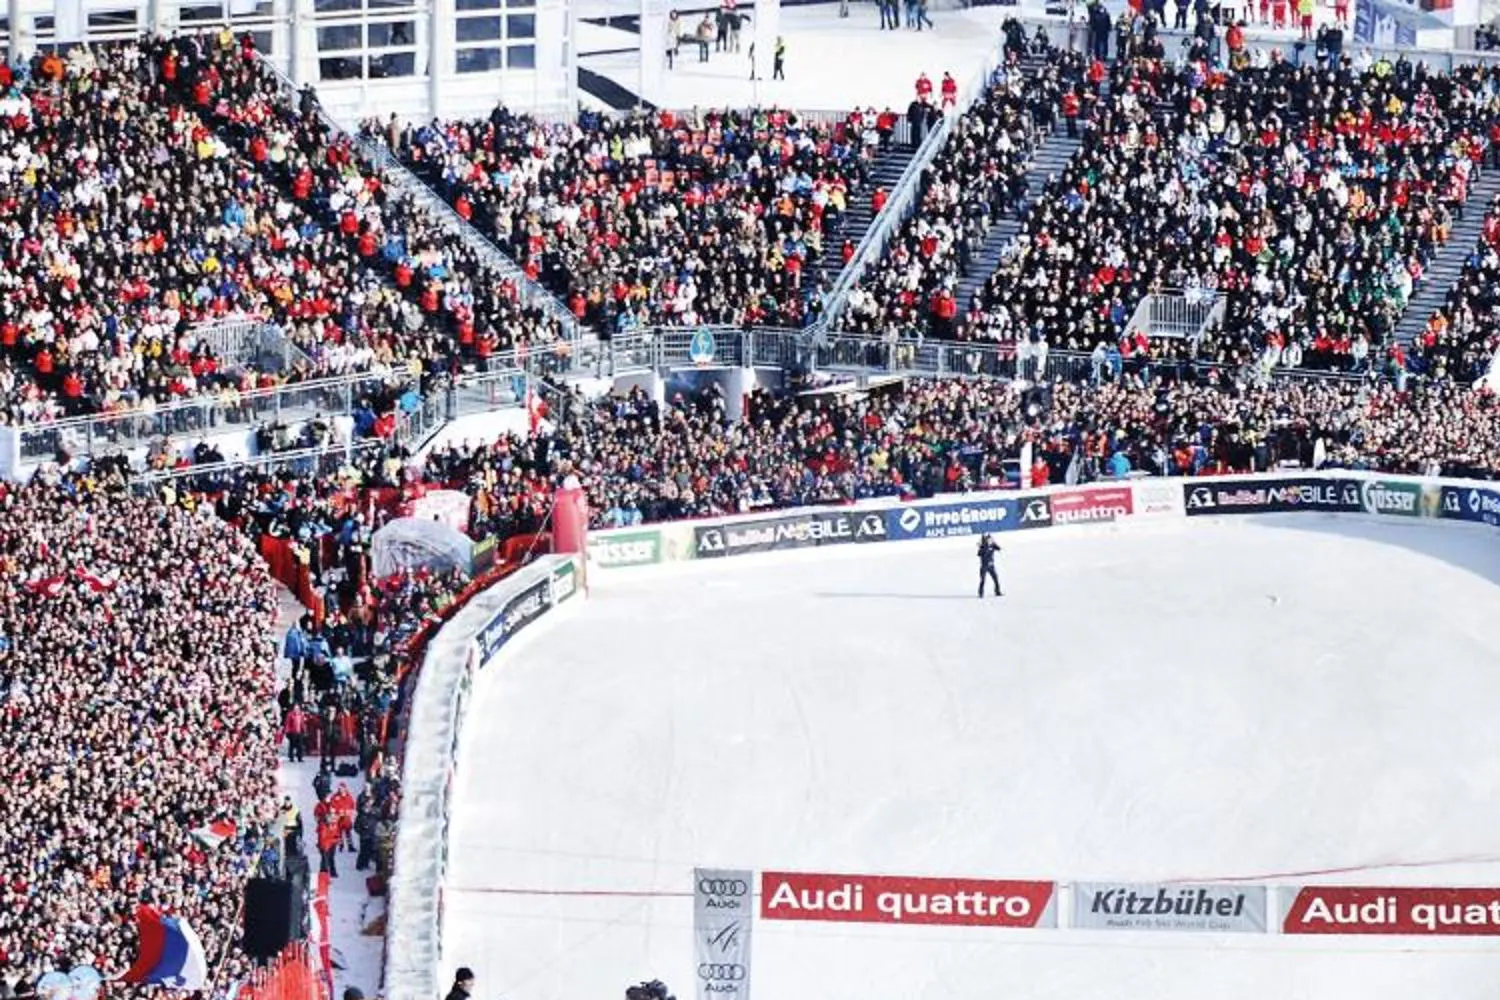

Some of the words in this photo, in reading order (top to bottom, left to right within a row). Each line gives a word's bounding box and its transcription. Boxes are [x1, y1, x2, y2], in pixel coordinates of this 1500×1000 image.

[1020, 499, 1051, 524] A1
[699, 530, 725, 551] A1
[857, 514, 887, 538] A1
[705, 898, 741, 909] Audi
[767, 882, 864, 911] Audi
[877, 892, 1030, 918] quattro
[1091, 888, 1246, 916] Kitzbühel
[1301, 897, 1397, 924] Audi
[705, 982, 739, 993] Audi
